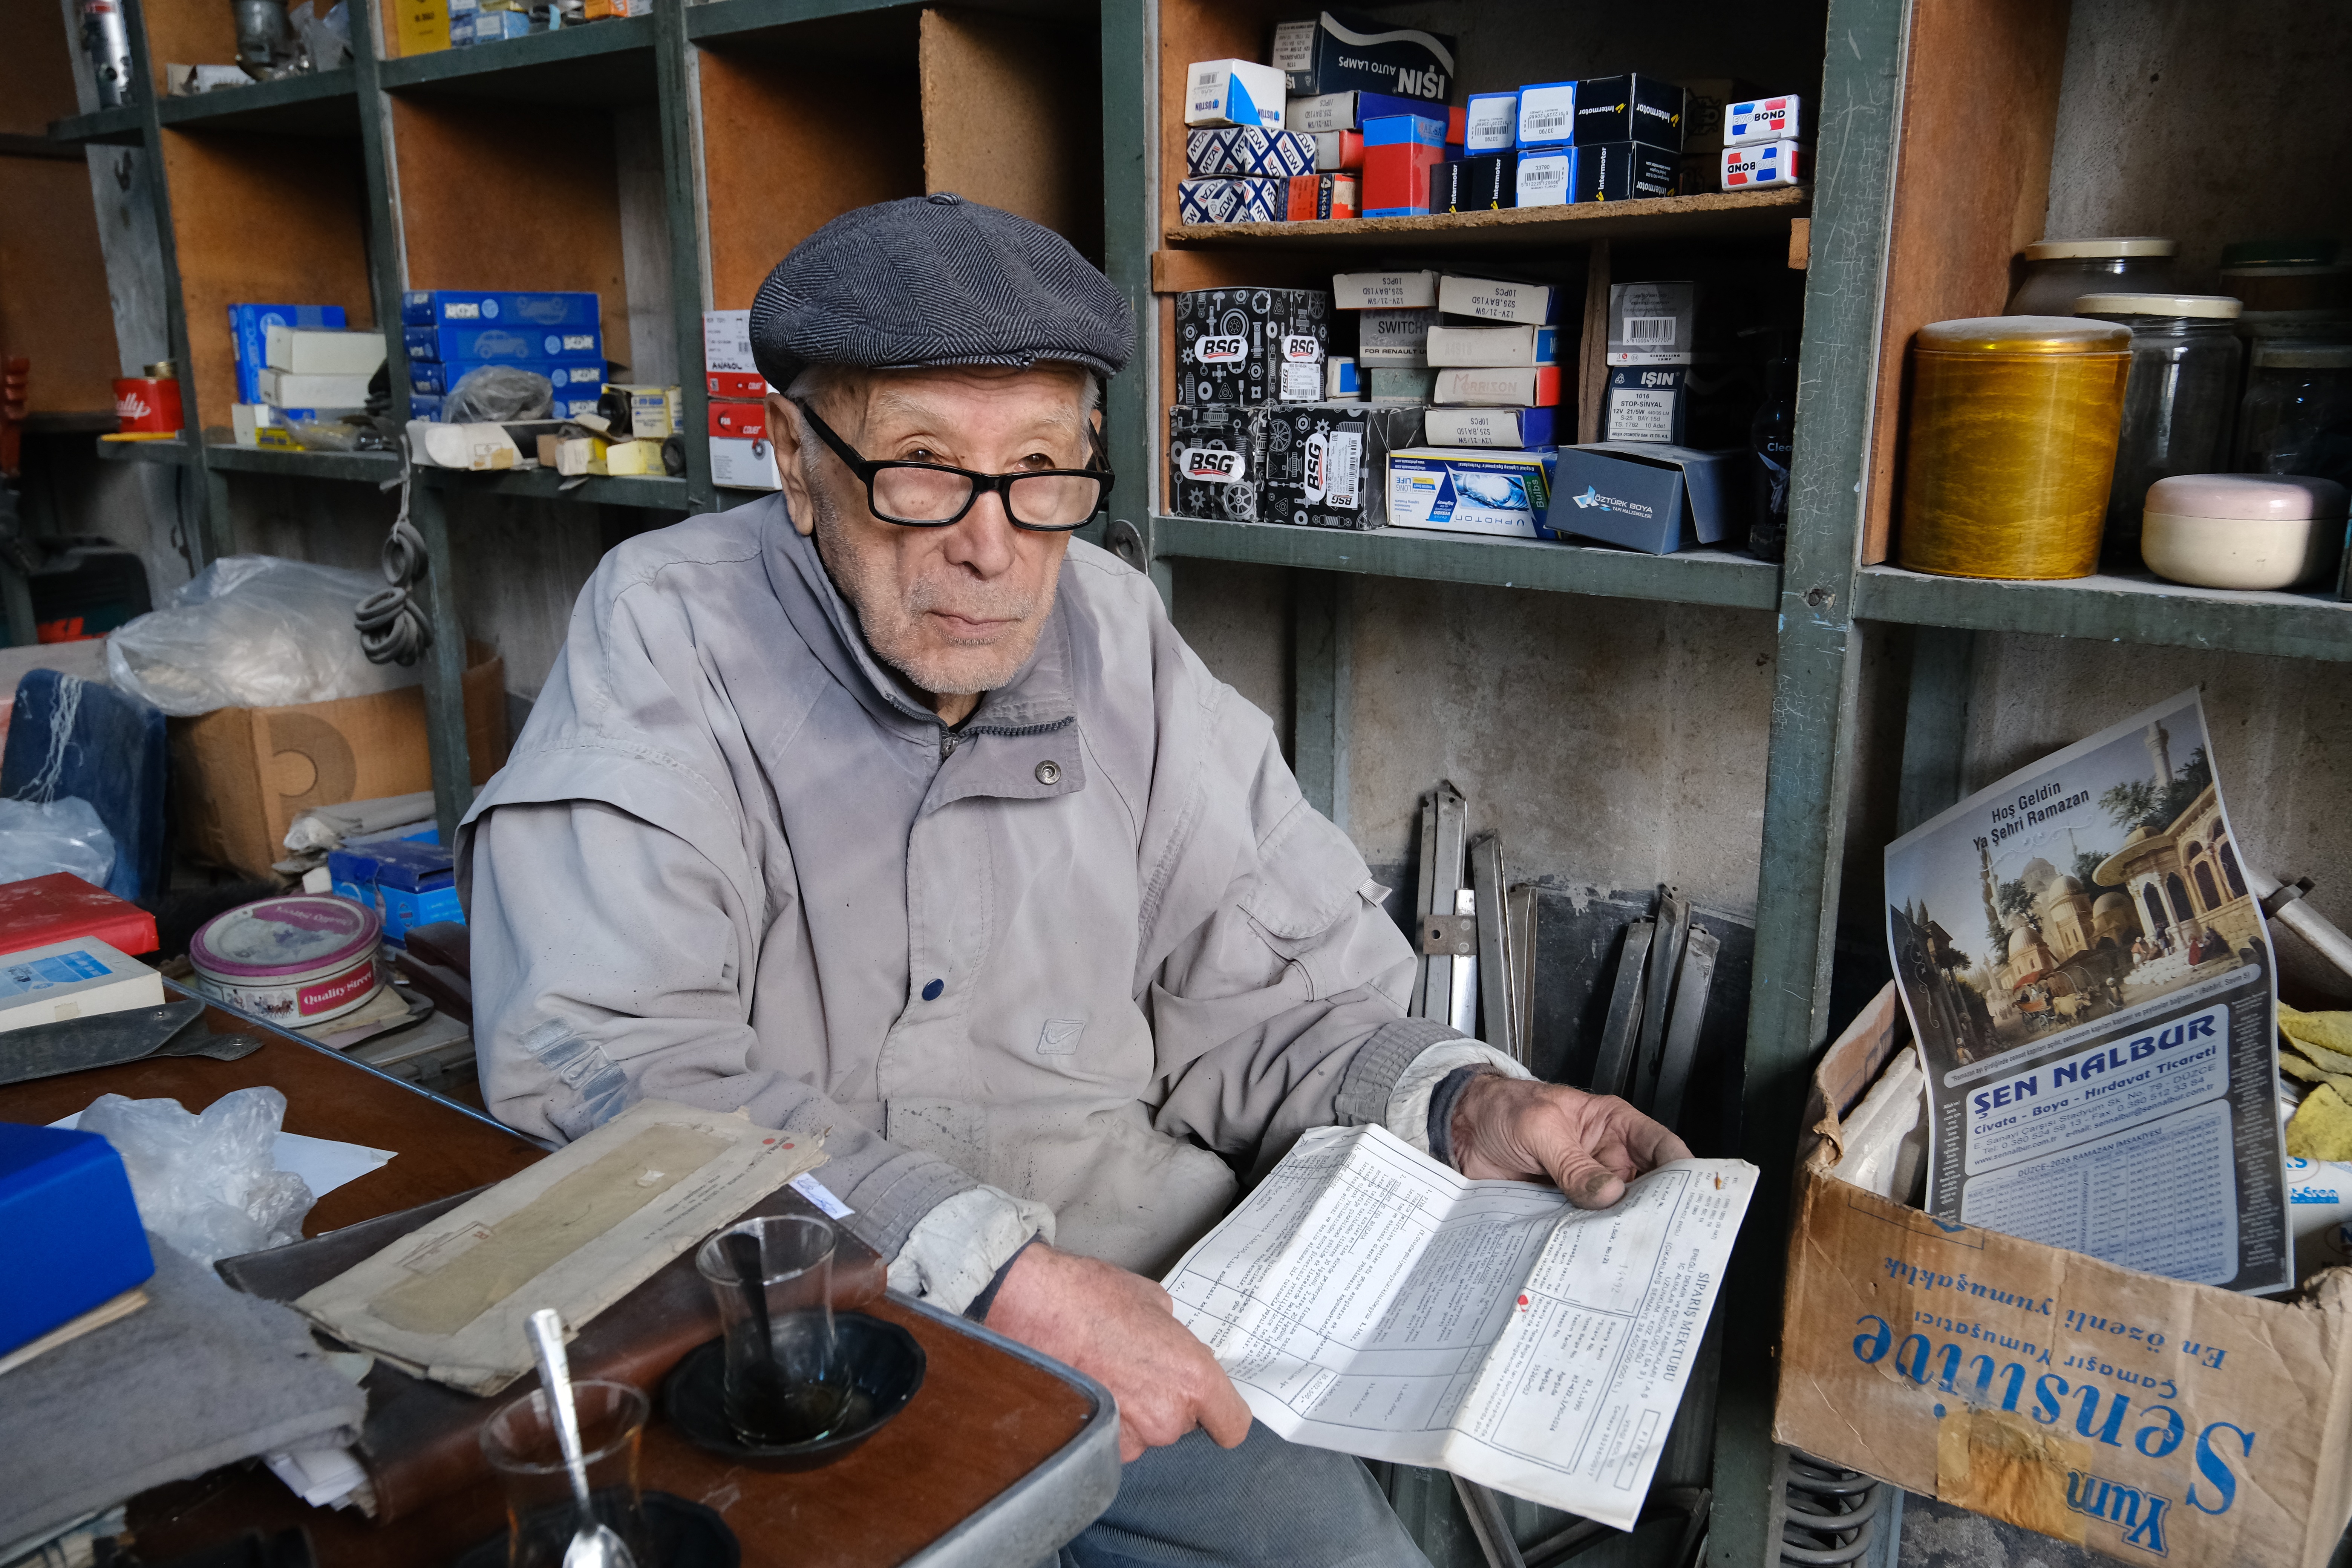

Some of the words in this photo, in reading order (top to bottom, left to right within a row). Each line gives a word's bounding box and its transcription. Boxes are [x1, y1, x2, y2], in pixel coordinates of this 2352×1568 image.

[1338, 55, 1369, 70] LAMPS
[1370, 62, 1396, 74] AUTO
[1397, 65, 1445, 100] IŞIN
[1194, 99, 1212, 112] ÜSTÜN
[1257, 108, 1273, 120] ÜSTÜN
[1578, 105, 1614, 115] Intermotor
[1636, 103, 1669, 123] Intermotor
[1732, 110, 1785, 125] EVOBOND
[1190, 132, 1207, 156] MTA
[1283, 143, 1299, 169] MTA
[1202, 148, 1219, 173] MTA
[1598, 147, 1606, 189] Intermotor
[1727, 158, 1776, 173] EVOBOND
[1493, 158, 1501, 199] Intermotor
[1635, 181, 1666, 197] Intermotor
[1218, 196, 1233, 217] MTA
[1472, 296, 1515, 308] S25,BAY15D
[1495, 288, 1516, 297] 10PCS
[1475, 307, 1513, 318] 12V-21/5W
[1378, 321, 1423, 334] SWITCH
[1203, 338, 1241, 355] BSG
[1290, 339, 1314, 355] BSG
[1641, 372, 1674, 387] IŞIN
[1767, 443, 1793, 452] Clea
[1190, 453, 1235, 474] BSG
[1306, 442, 1323, 490] BSG
[1331, 495, 1352, 505] BSG
[1532, 479, 1544, 507] Bulbs
[1594, 493, 1628, 508] ÖZTÜRK
[1629, 503, 1653, 513] BOYA
[1455, 514, 1512, 525] PHOTON
[1622, 508, 1652, 519] MALZEMELERİ
[1992, 804, 2016, 823] Hoş
[2018, 780, 2061, 811] Geldin
[1973, 835, 1988, 852] Ya
[1991, 813, 2026, 845] Şehri
[2026, 787, 2090, 829] Ramazan
[303, 987, 346, 1005] Quality
[347, 971, 372, 992] Street
[1983, 1057, 2009, 1072] girdiğinde
[2009, 1051, 2027, 1062] cennet
[2062, 1028, 2090, 1043] cehennem
[2111, 1012, 2134, 1026] kapanır
[2142, 1000, 2170, 1015] şeytanlar
[1970, 1074, 2044, 1120] ŞEN
[2047, 1013, 2222, 1090] NALBUR
[1973, 1113, 2018, 1136] Civata
[2030, 1096, 2070, 1118] Boya
[2082, 1068, 2153, 1101] Hırdavat
[2155, 1045, 2219, 1075] Ticareti
[1981, 1144, 2001, 1156] Tel:
[2030, 1127, 2051, 1141] 524
[2051, 1122, 2067, 1133] 59
[2068, 1117, 2082, 1128] 13
[2148, 1088, 2169, 1101] 512
[2171, 1081, 2188, 1093] 33
[2188, 1075, 2206, 1087] 84
[1985, 1129, 2021, 1147] Sanayi
[2020, 1117, 2056, 1136] Çarşısı
[2057, 1101, 2105, 1124] Stadyum
[2148, 1081, 2164, 1093] 79
[2171, 1062, 2217, 1084] DÜZCE
[1973, 1133, 2058, 1168] www.sennalbur.com.tr
[2092, 1081, 2216, 1130] sennalbur@sennalbur.com.tr
[2017, 1154, 2072, 1180] DÜZCE-2026
[2071, 1141, 2115, 1162] RAMAZAN
[2113, 1125, 2164, 1149] İMSAKİYESİ
[1331, 1207, 1356, 1239] çıkabilecek
[1352, 1215, 1369, 1237] araçlar
[1375, 1219, 1395, 1243] eksiksiz
[1386, 1213, 1408, 1242] belirtilen
[1339, 1243, 1351, 1257] kısa
[1347, 1236, 1355, 1245] en
[1364, 1242, 1379, 1261] olarak
[1370, 1241, 1389, 1265] fiyatlar
[1326, 1256, 1342, 1276] sürede
[1342, 1260, 1367, 1293] yapılmasını
[1364, 1264, 1374, 1276] adı
[1306, 1274, 1330, 1305] peyderpey
[1352, 1274, 1367, 1291] geçen
[1667, 1272, 1682, 1304] ALIMLAR
[1678, 1274, 1691, 1298] DEMİR
[1683, 1270, 1712, 1319] SİPARİŞ
[1884, 1256, 2054, 1317] yumuşaklık
[1334, 1291, 1358, 1321] araçların
[1640, 1287, 1657, 1321] SERMAYE
[1653, 1276, 1671, 1314] UZUNKUM
[1674, 1299, 1682, 1309] ve
[1330, 1321, 1338, 1330] ek
[1666, 1309, 1680, 1329] ÇELİK
[2064, 1308, 2166, 1353] özenli
[1602, 1320, 1617, 1343] Sipariş
[1913, 1311, 2053, 1366] Yumuşatıcı
[1308, 1330, 1332, 1362] listelerde
[1649, 1330, 1671, 1378] FABRİKALARI
[1661, 1319, 1693, 1383] MEKTUBU
[2181, 1340, 2230, 1370] En
[2064, 1355, 2179, 1399] Çamaşır
[1853, 1314, 2256, 1516] Sensitive
[2066, 1469, 2170, 1556] Yum
